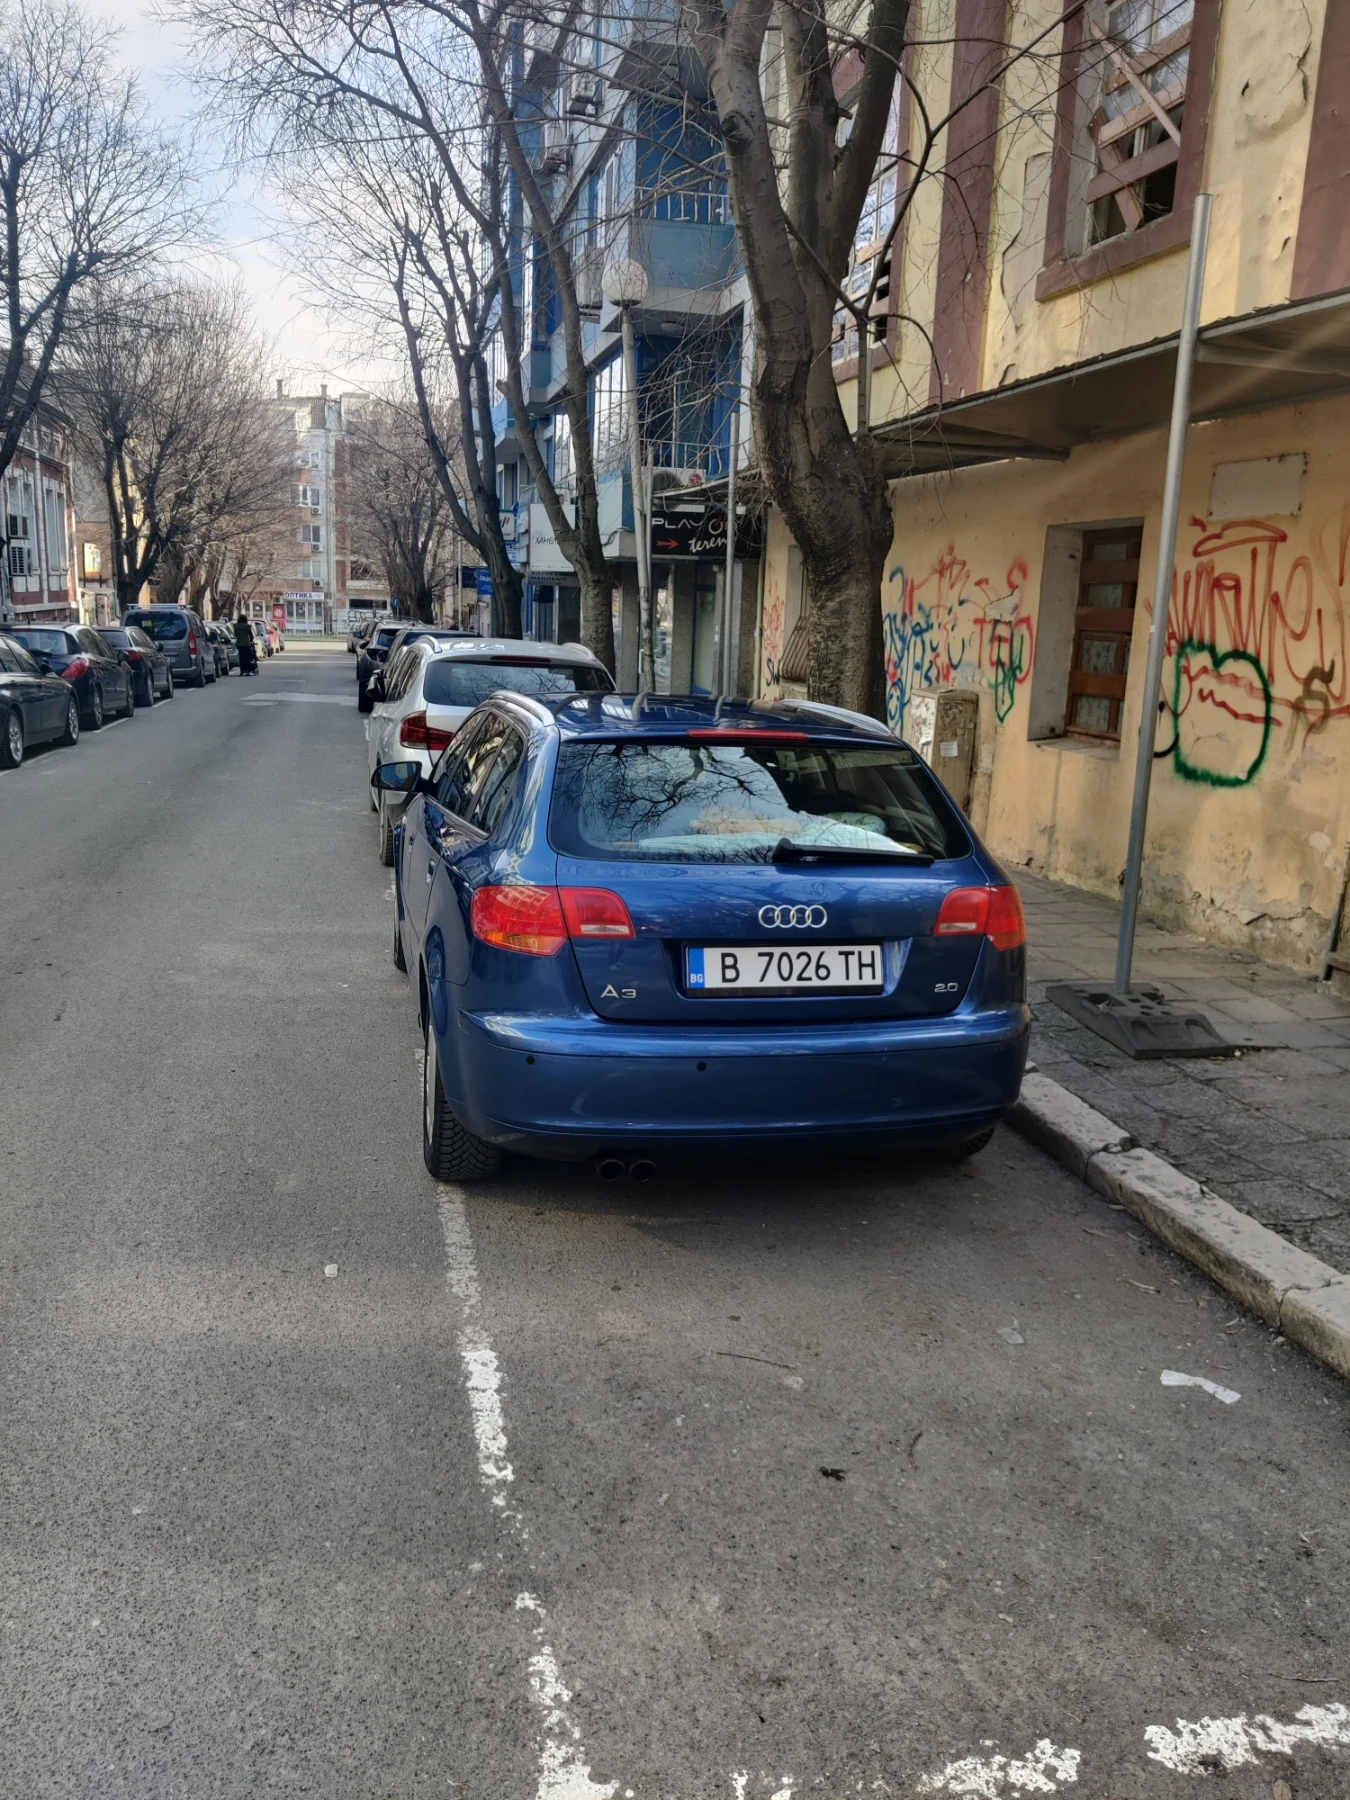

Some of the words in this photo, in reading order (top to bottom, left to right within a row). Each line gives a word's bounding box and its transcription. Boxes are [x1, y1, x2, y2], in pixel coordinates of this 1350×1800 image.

[651, 517, 703, 532] PLAY
[690, 974, 704, 983] BG
[720, 952, 740, 983] B
[757, 951, 831, 983] 7026
[838, 950, 876, 980] TH
[600, 984, 637, 999] A3
[934, 982, 958, 992] 2.0
